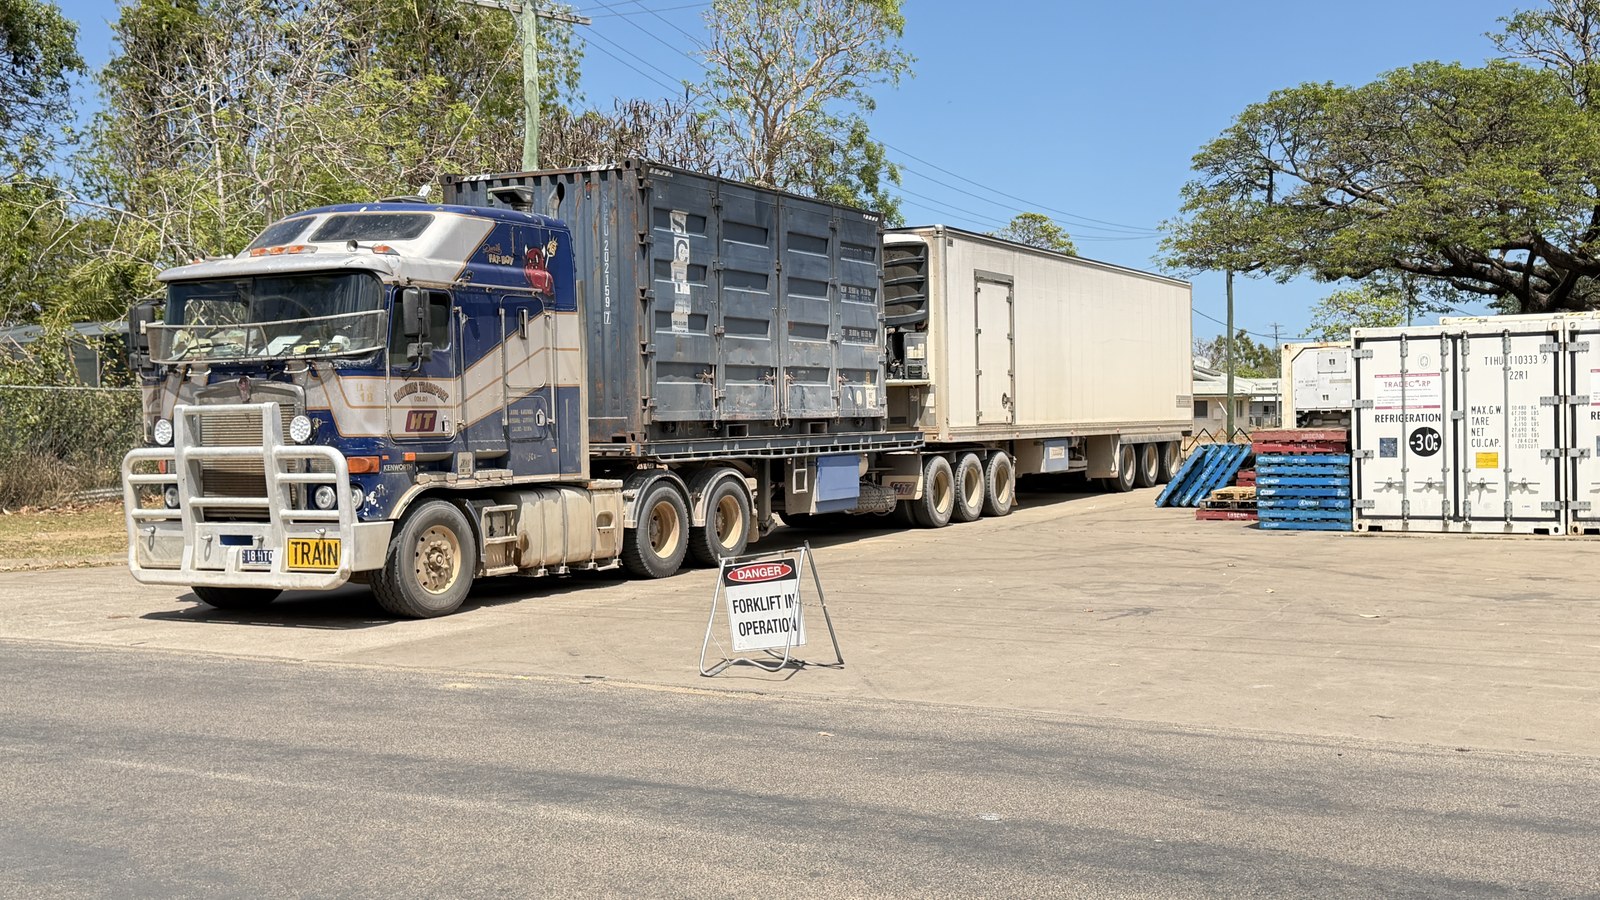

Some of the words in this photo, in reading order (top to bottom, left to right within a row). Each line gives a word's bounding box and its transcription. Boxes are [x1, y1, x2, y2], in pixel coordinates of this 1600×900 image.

[1484, 356, 1504, 366] TIHU
[1509, 355, 1538, 365] 110333
[1542, 354, 1548, 364] 9
[1509, 370, 1528, 380] 22R1
[410, 413, 434, 430] HT
[1374, 413, 1441, 423] REFRIGERATION
[1471, 416, 1490, 426] TARE
[1471, 427, 1485, 437] NET
[1471, 438, 1502, 448] CU.CAP.
[383, 463, 413, 472] KENWORTH
[291, 541, 338, 566] TRAIN
[737, 566, 782, 580] DANGER
[732, 595, 781, 614] FORKLIFT
[784, 593, 796, 608] IN
[738, 617, 797, 636] OPERATION
